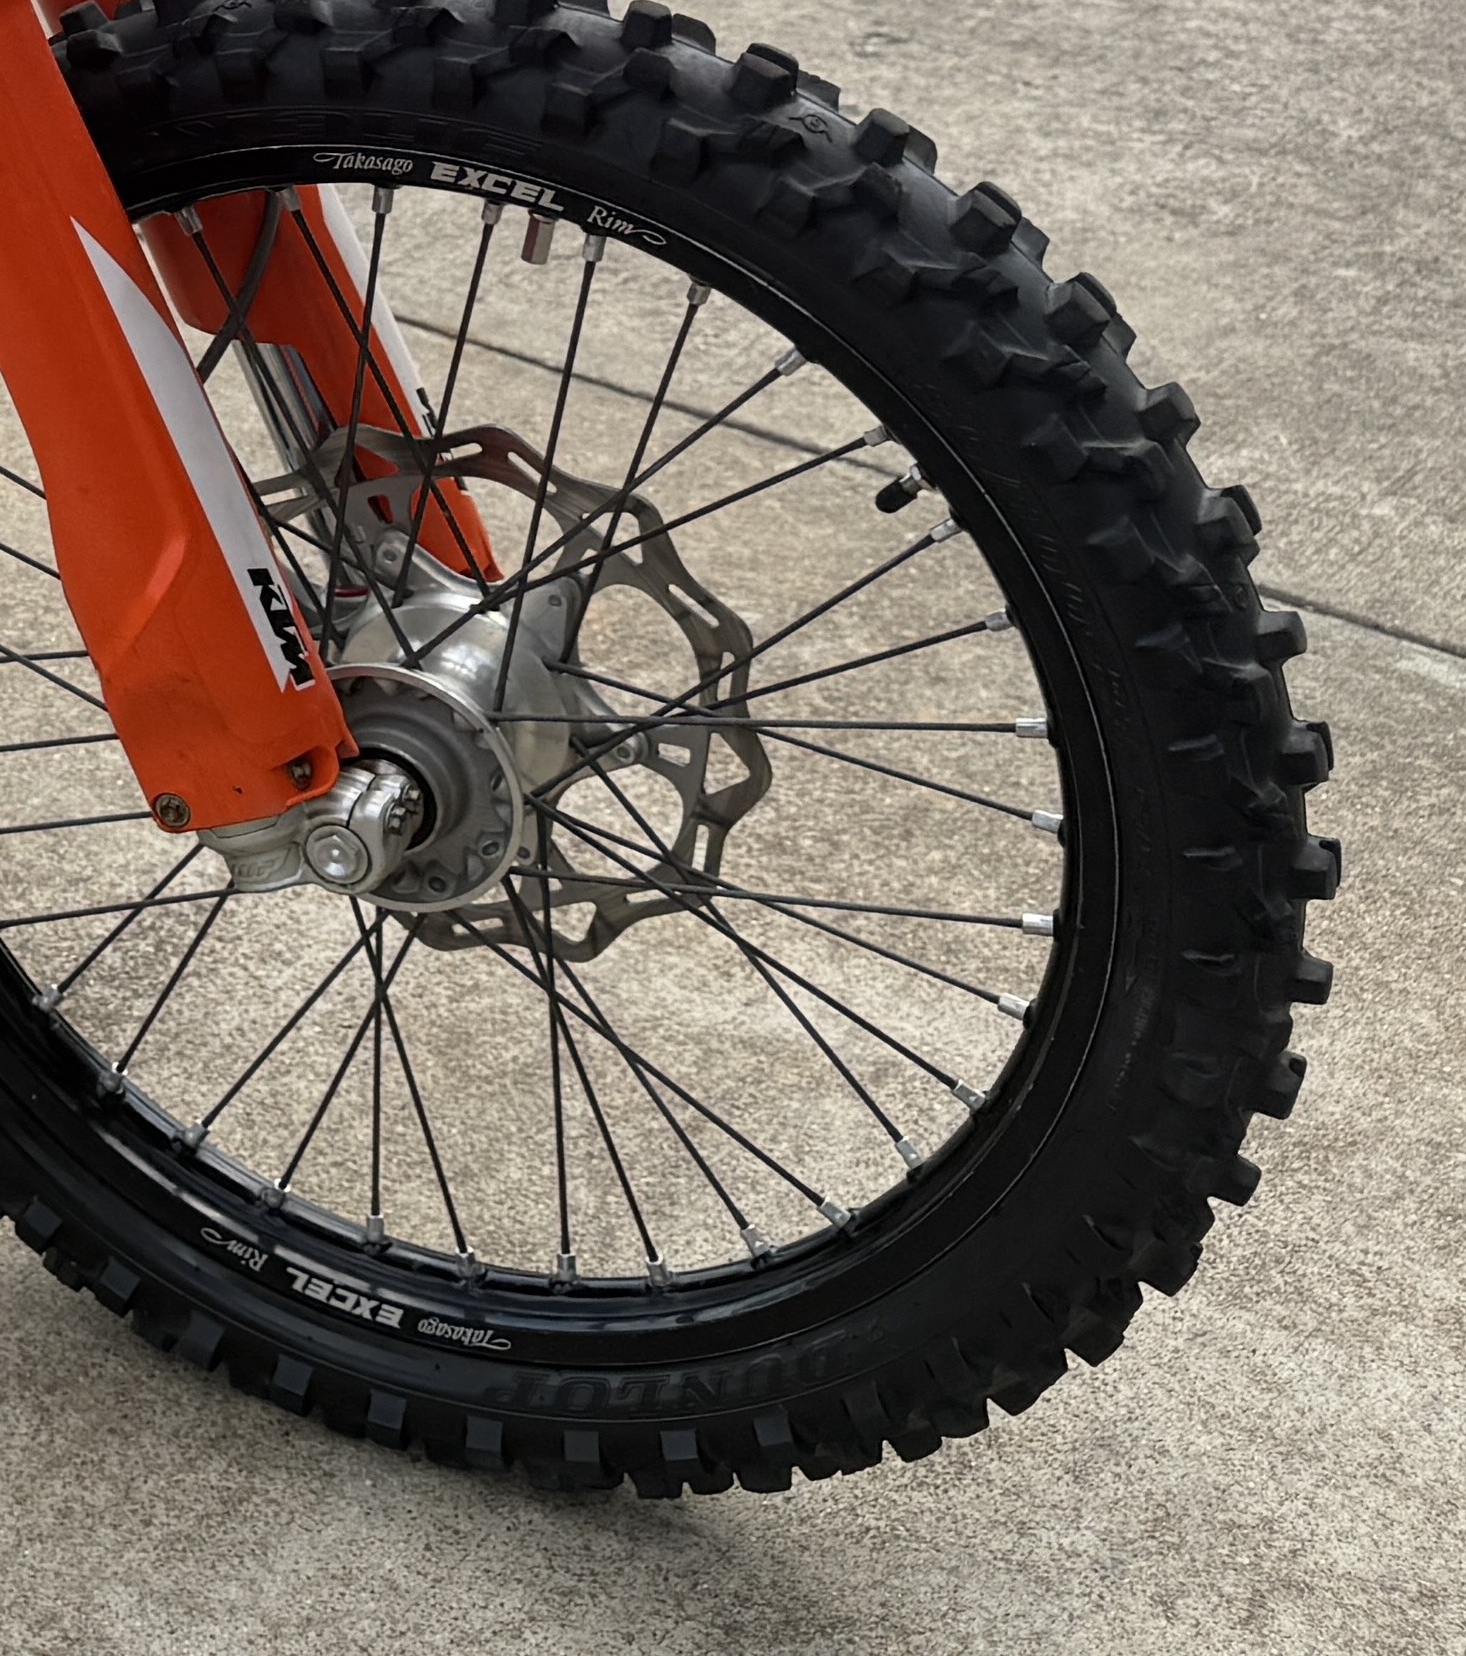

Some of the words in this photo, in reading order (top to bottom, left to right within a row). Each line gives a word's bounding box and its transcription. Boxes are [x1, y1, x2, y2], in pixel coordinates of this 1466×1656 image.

[312, 151, 414, 176] Takasago
[429, 161, 565, 212] EXCEL
[587, 195, 668, 246] Rim
[247, 567, 316, 689] KTM
[200, 1227, 269, 1273] Rim
[285, 1266, 405, 1330] EXCEL
[418, 1316, 512, 1352] Takasago
